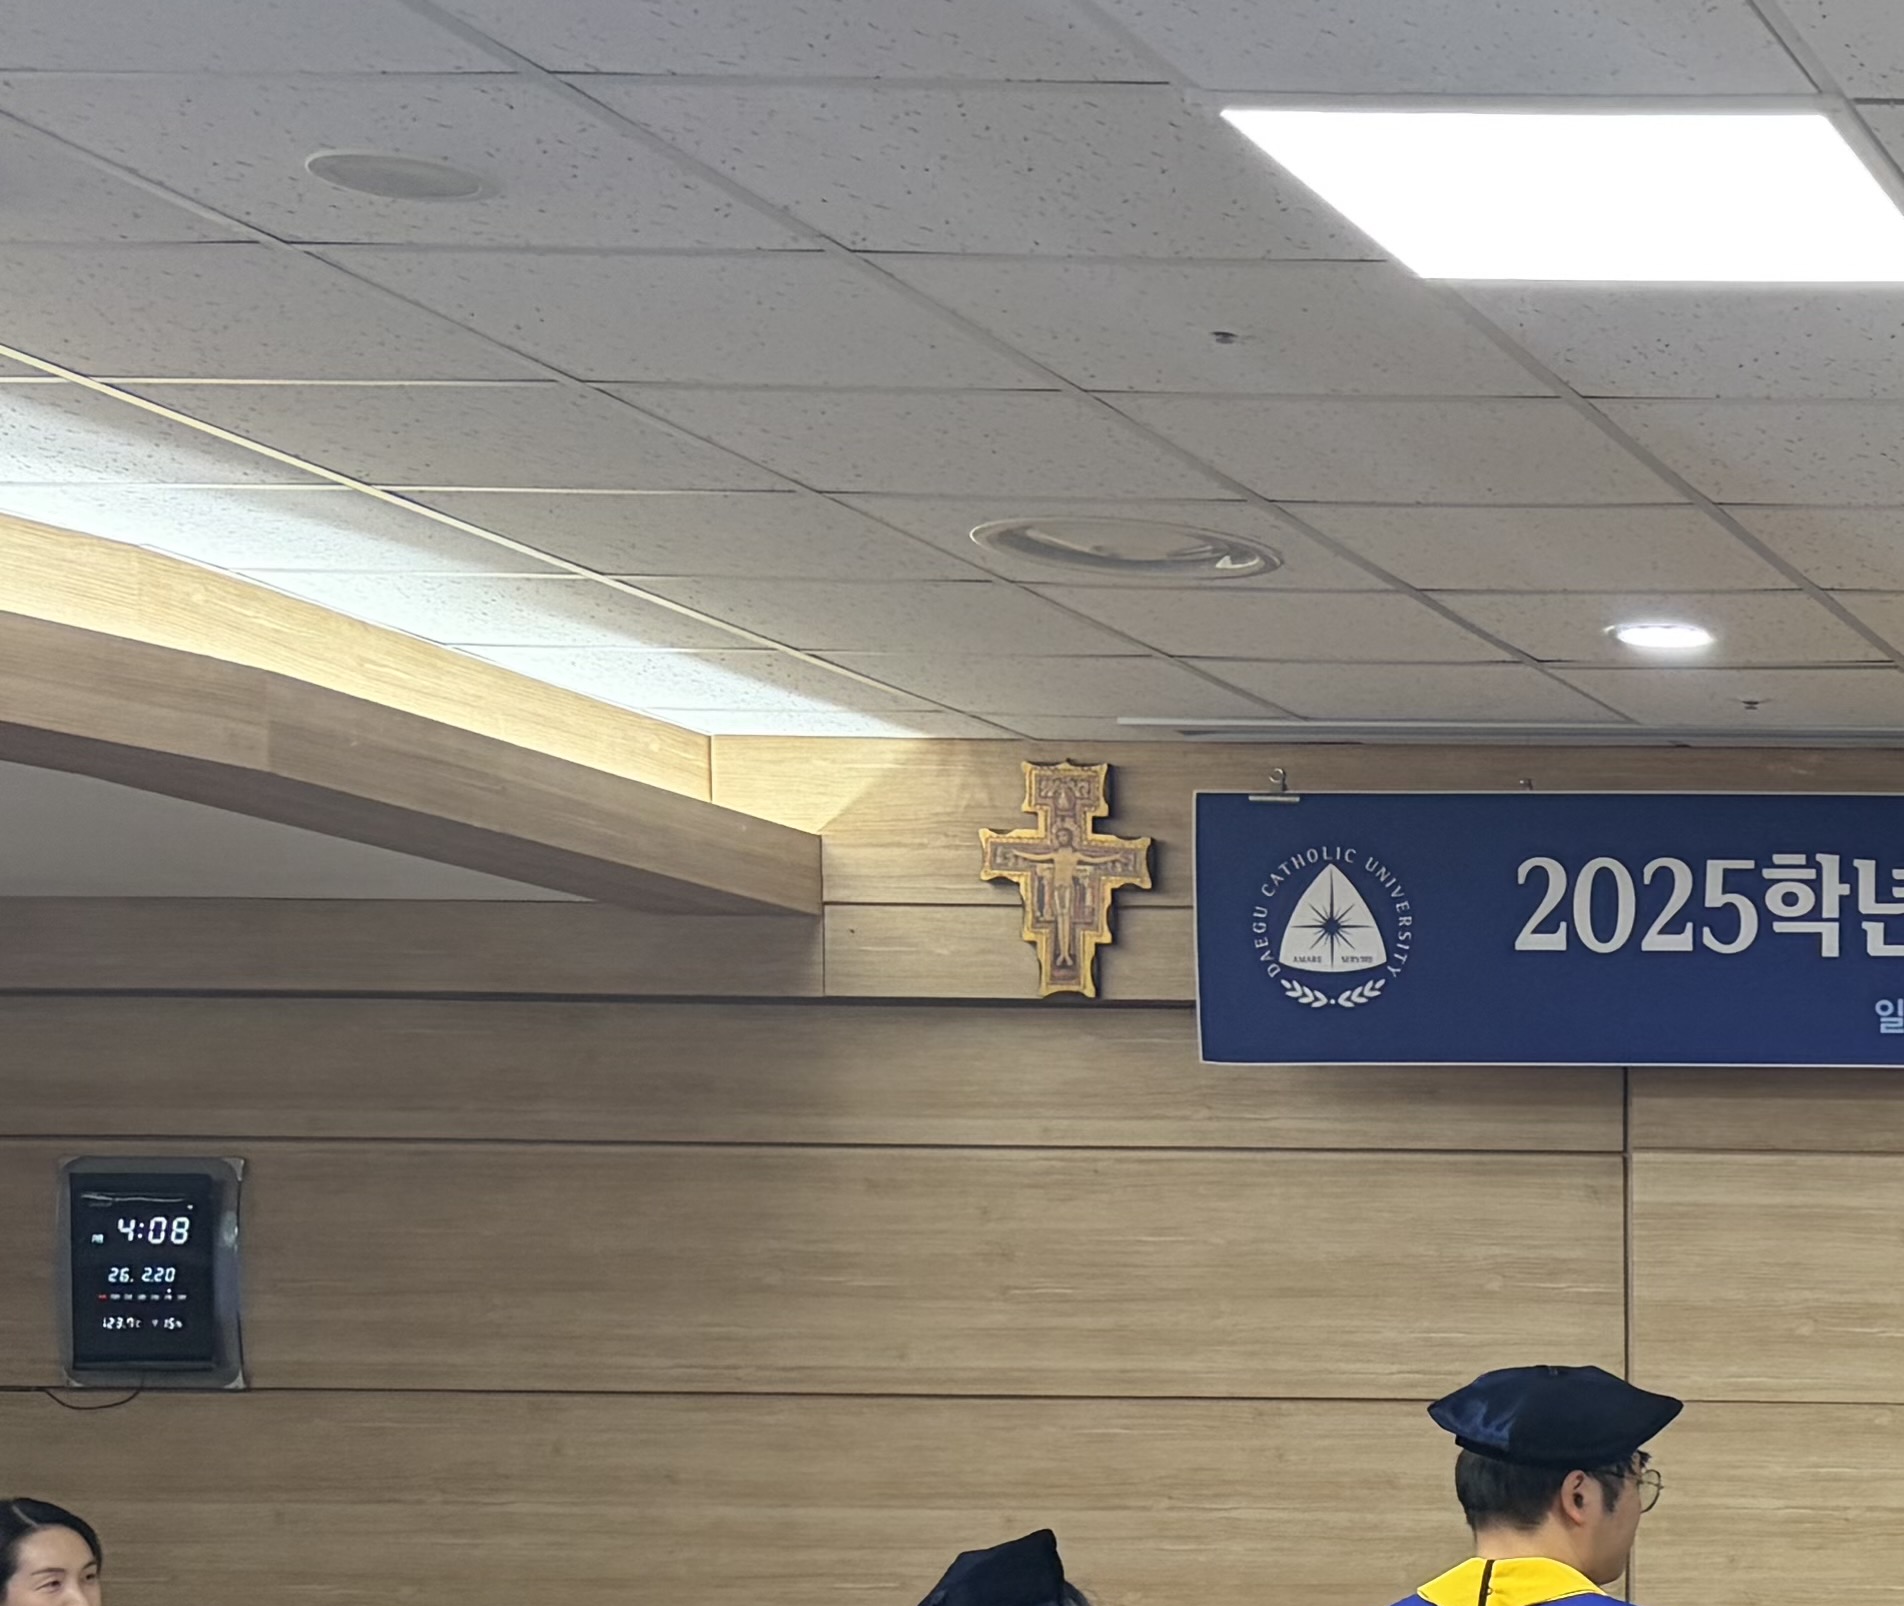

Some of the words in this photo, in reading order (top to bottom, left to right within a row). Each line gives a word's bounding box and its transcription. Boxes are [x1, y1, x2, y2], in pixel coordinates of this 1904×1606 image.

[1261, 846, 1357, 897] CATHOLIC
[1252, 906, 1281, 978] DAEGU
[1364, 857, 1412, 977] UNIVERSITY
[117, 1216, 190, 1245] 4:08
